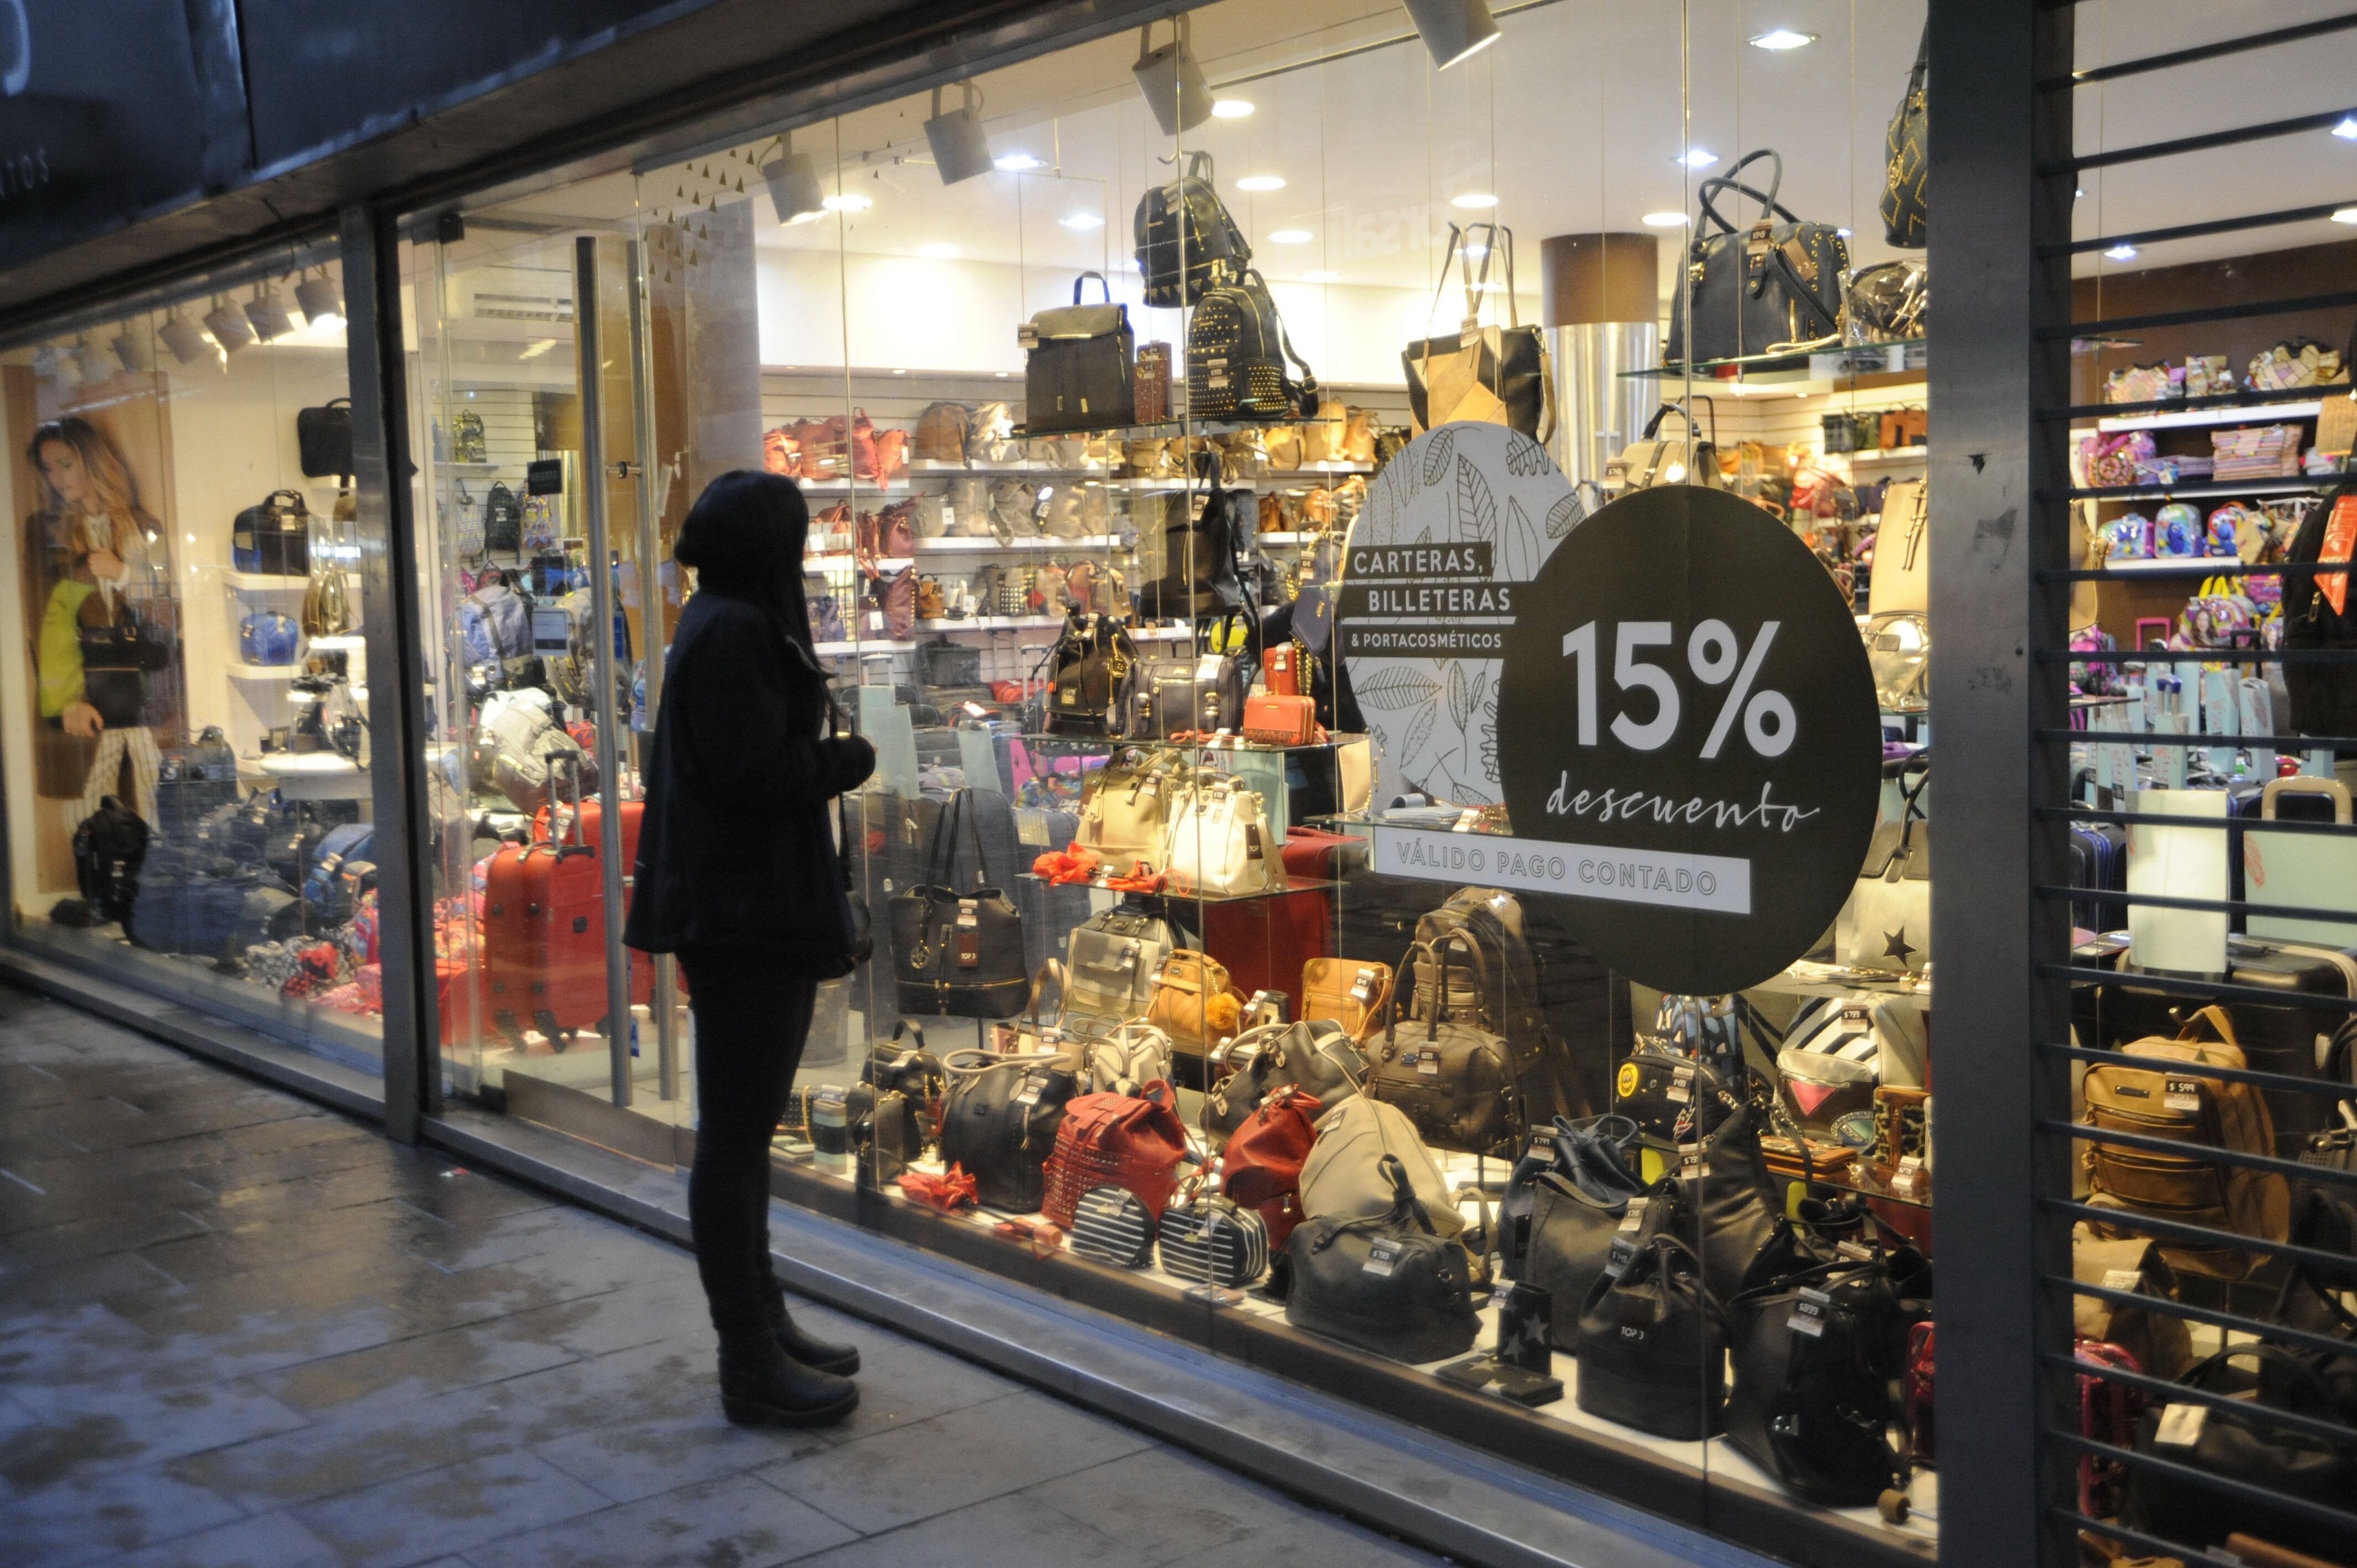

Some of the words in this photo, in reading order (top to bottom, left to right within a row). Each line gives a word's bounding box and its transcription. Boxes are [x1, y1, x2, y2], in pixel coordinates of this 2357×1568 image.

[0, 146, 49, 199] TOS
[1354, 548, 1483, 574] CARTERAS,
[1369, 588, 1510, 612] BILLETERAS
[1351, 633, 1358, 647] &
[1363, 630, 1502, 648] PORTACOSMÉTICOS
[1562, 618, 1797, 759] 15%
[1546, 770, 1820, 832] descuento
[1397, 838, 1485, 871] VÁLIDO
[1497, 852, 1565, 880] PAGO
[1578, 860, 1717, 896] CONTADO
[1684, 1156, 1698, 1164] $79
[1799, 1302, 1819, 1316] $899
[1621, 1326, 1637, 1337] TOP
[1638, 1330, 1644, 1340] 3
